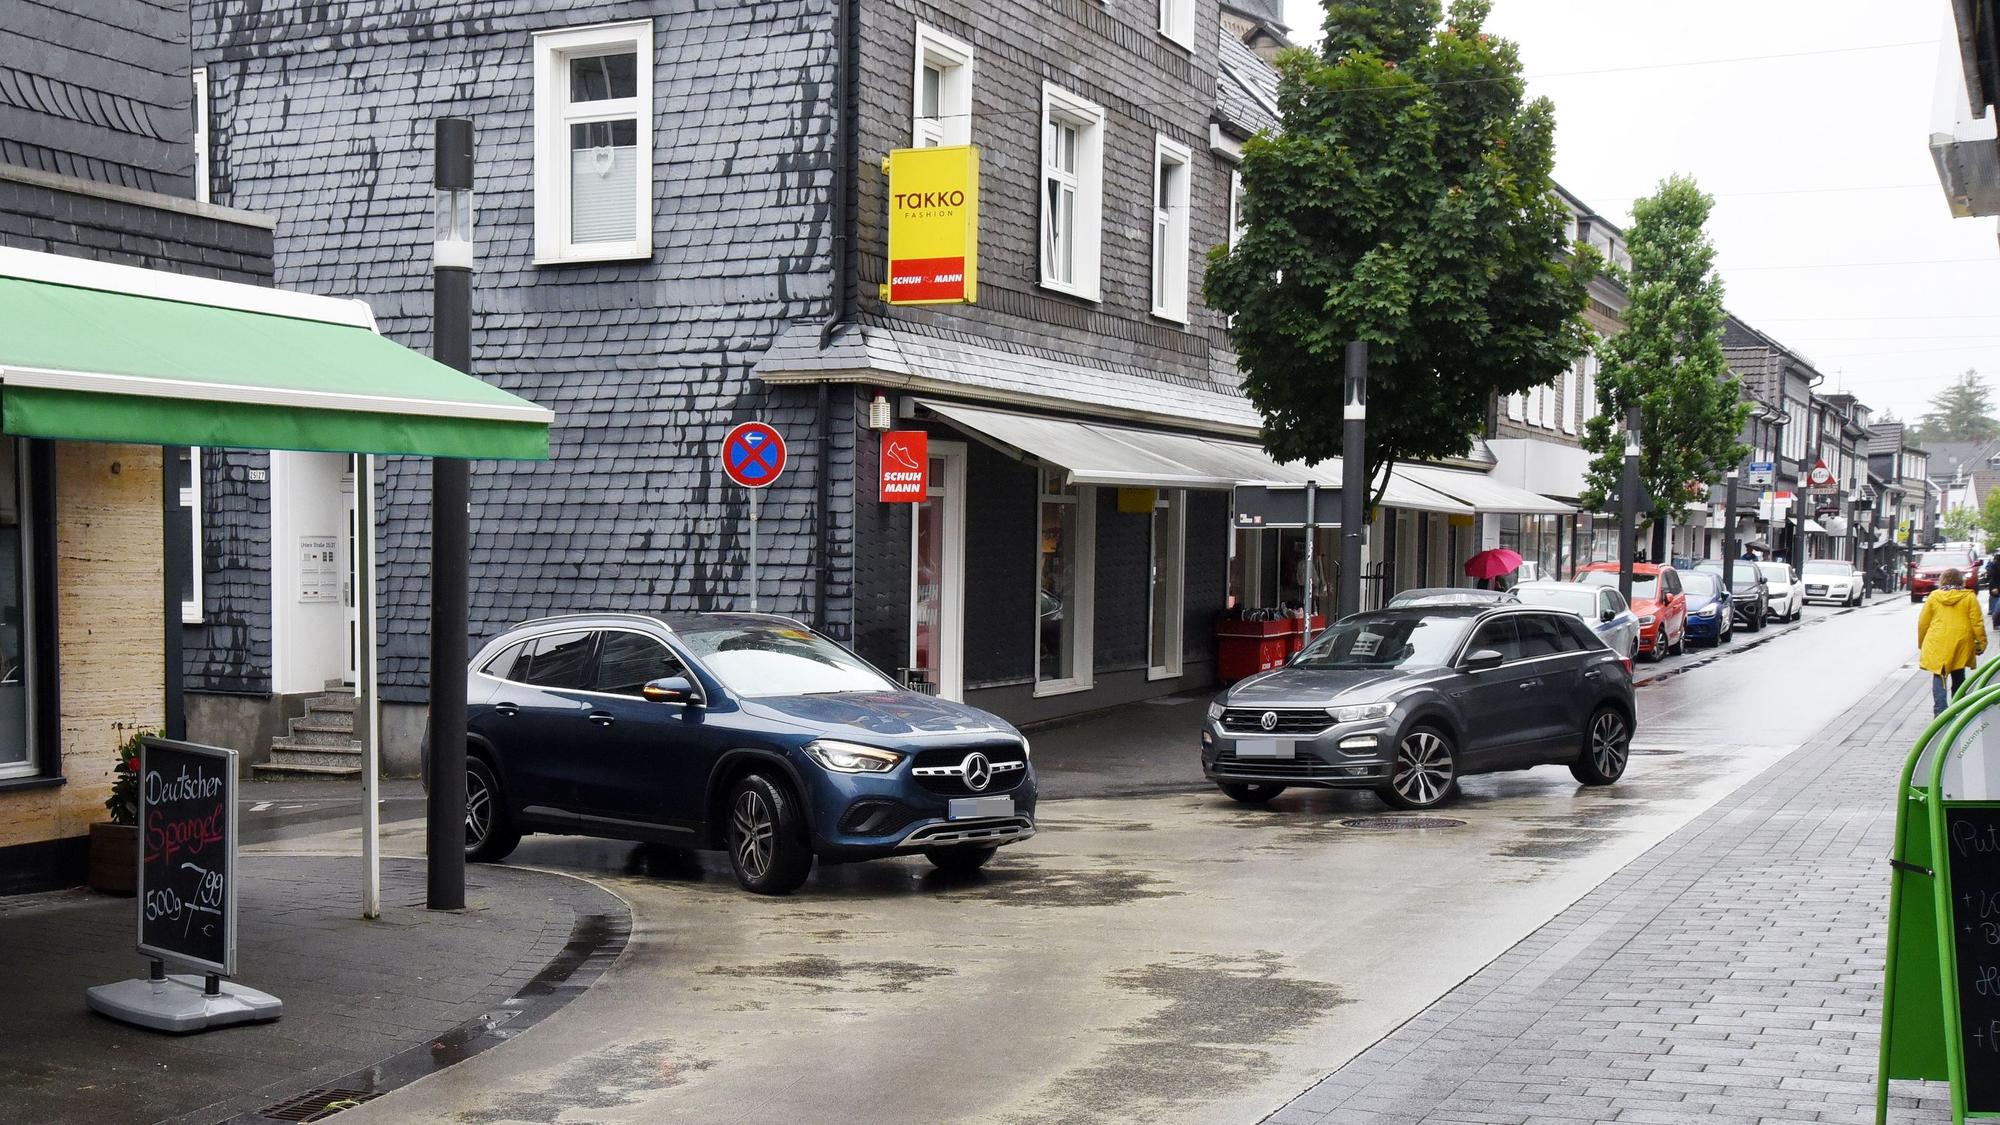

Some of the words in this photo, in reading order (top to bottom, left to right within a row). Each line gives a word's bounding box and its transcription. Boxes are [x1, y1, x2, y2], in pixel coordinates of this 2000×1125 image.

[905, 211, 953, 219] FASHION
[892, 276, 921, 285] SCHUH
[934, 274, 962, 283] MANN
[884, 472, 922, 481] SCHUH
[885, 483, 920, 493] MANN
[146, 765, 222, 805] Deutscher
[145, 803, 223, 864] Spargel
[146, 888, 181, 921] 500g
